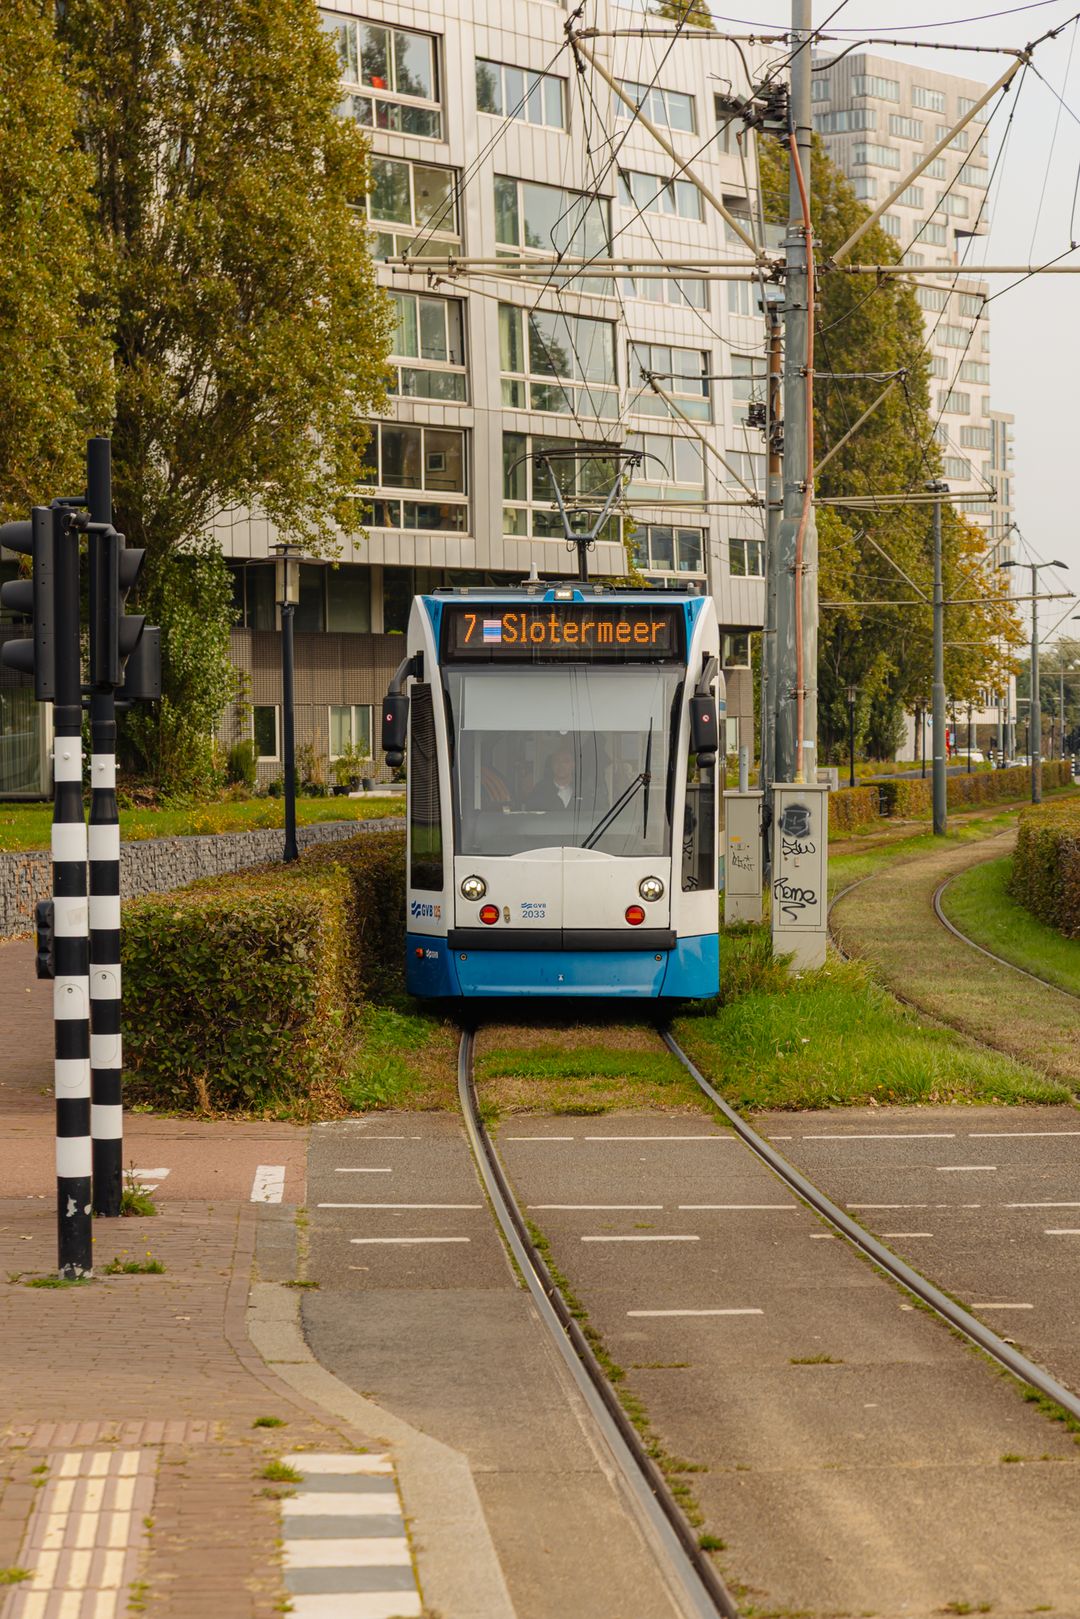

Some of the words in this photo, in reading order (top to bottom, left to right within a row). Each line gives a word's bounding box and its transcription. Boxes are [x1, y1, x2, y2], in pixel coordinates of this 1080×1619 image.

[464, 614, 477, 643] 7
[502, 613, 666, 643] Slotermeer
[421, 903, 433, 917] GVB
[522, 910, 545, 919] 2033
